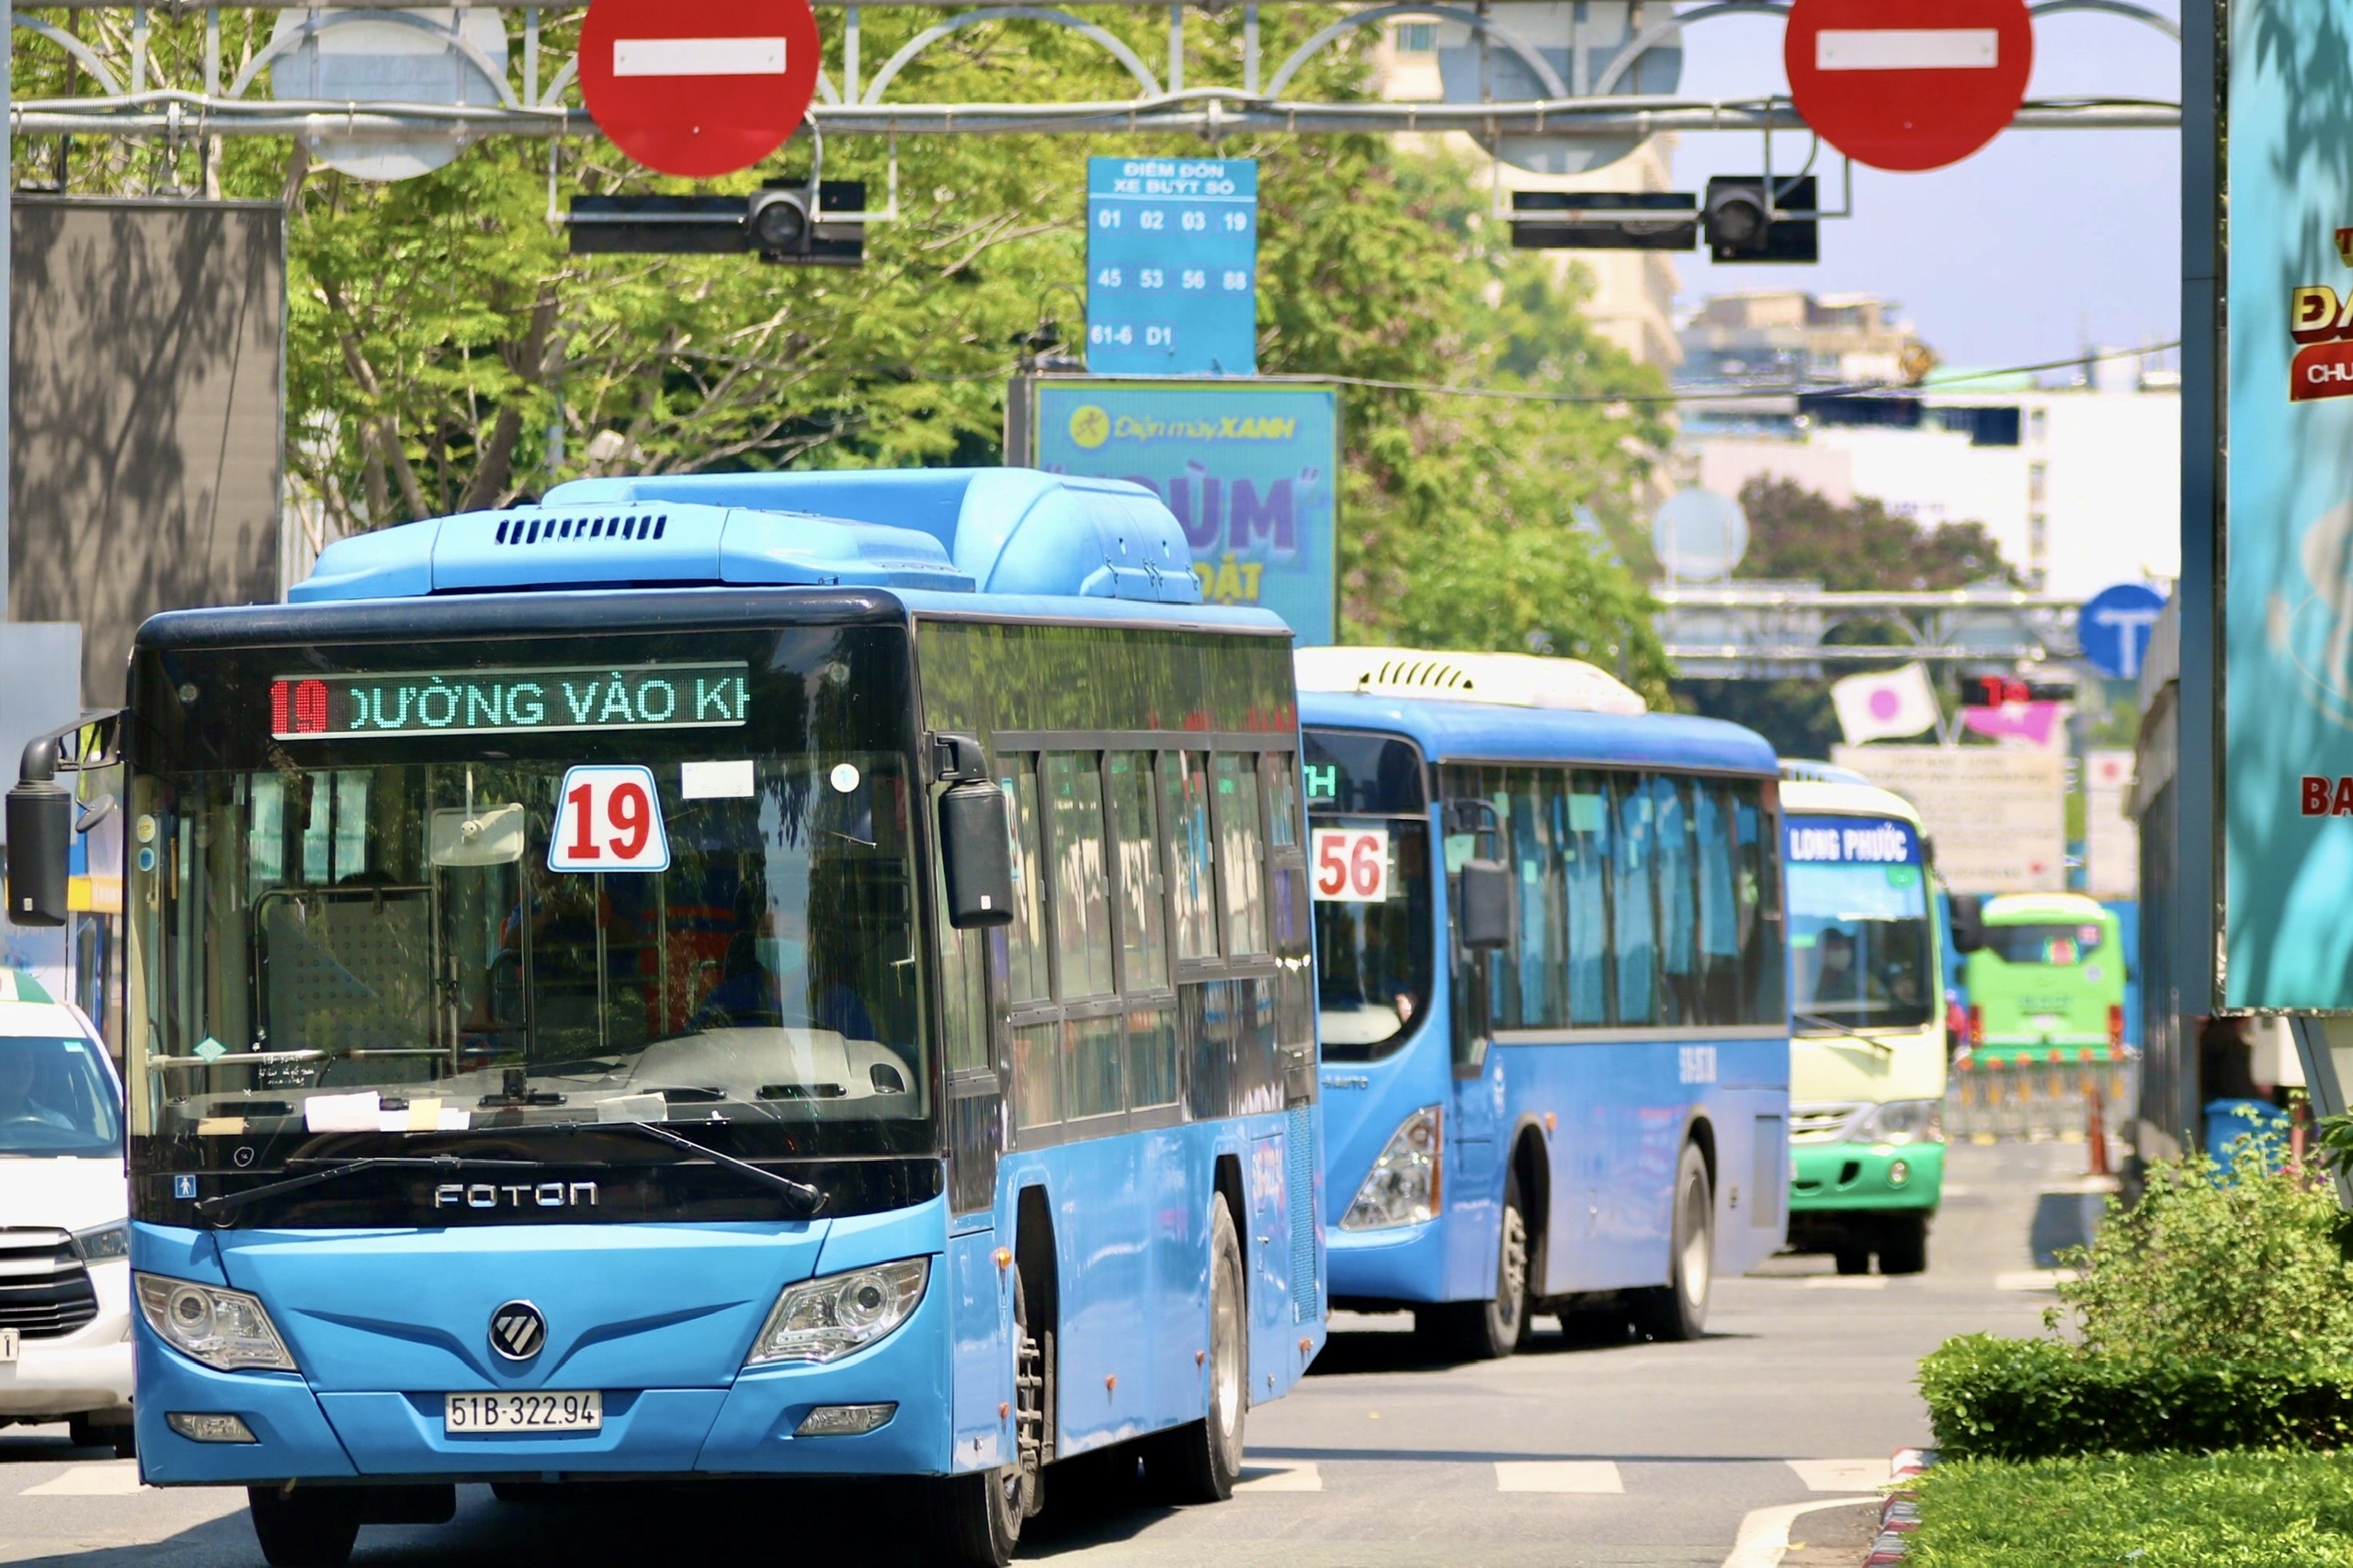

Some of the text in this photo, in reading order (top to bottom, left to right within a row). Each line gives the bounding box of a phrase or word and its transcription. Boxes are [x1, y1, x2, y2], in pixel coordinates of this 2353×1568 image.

[1114, 179, 1141, 194] XE
[1098, 209, 1247, 231] 01 02 03 19
[1097, 268, 1122, 288] 45
[1140, 269, 1164, 289] 53
[1182, 270, 1205, 290] 56
[1091, 324, 1171, 346] 61-6 D1
[1219, 416, 1296, 439] XANH
[269, 679, 327, 733] 19
[563, 671, 676, 723] VÀO
[1303, 765, 1336, 797] H
[567, 782, 651, 859] 19
[1790, 828, 1840, 860] LONG
[1318, 835, 1381, 897] 56
[435, 1182, 599, 1209] FOTON
[451, 1395, 596, 1426] 51B-322.94
